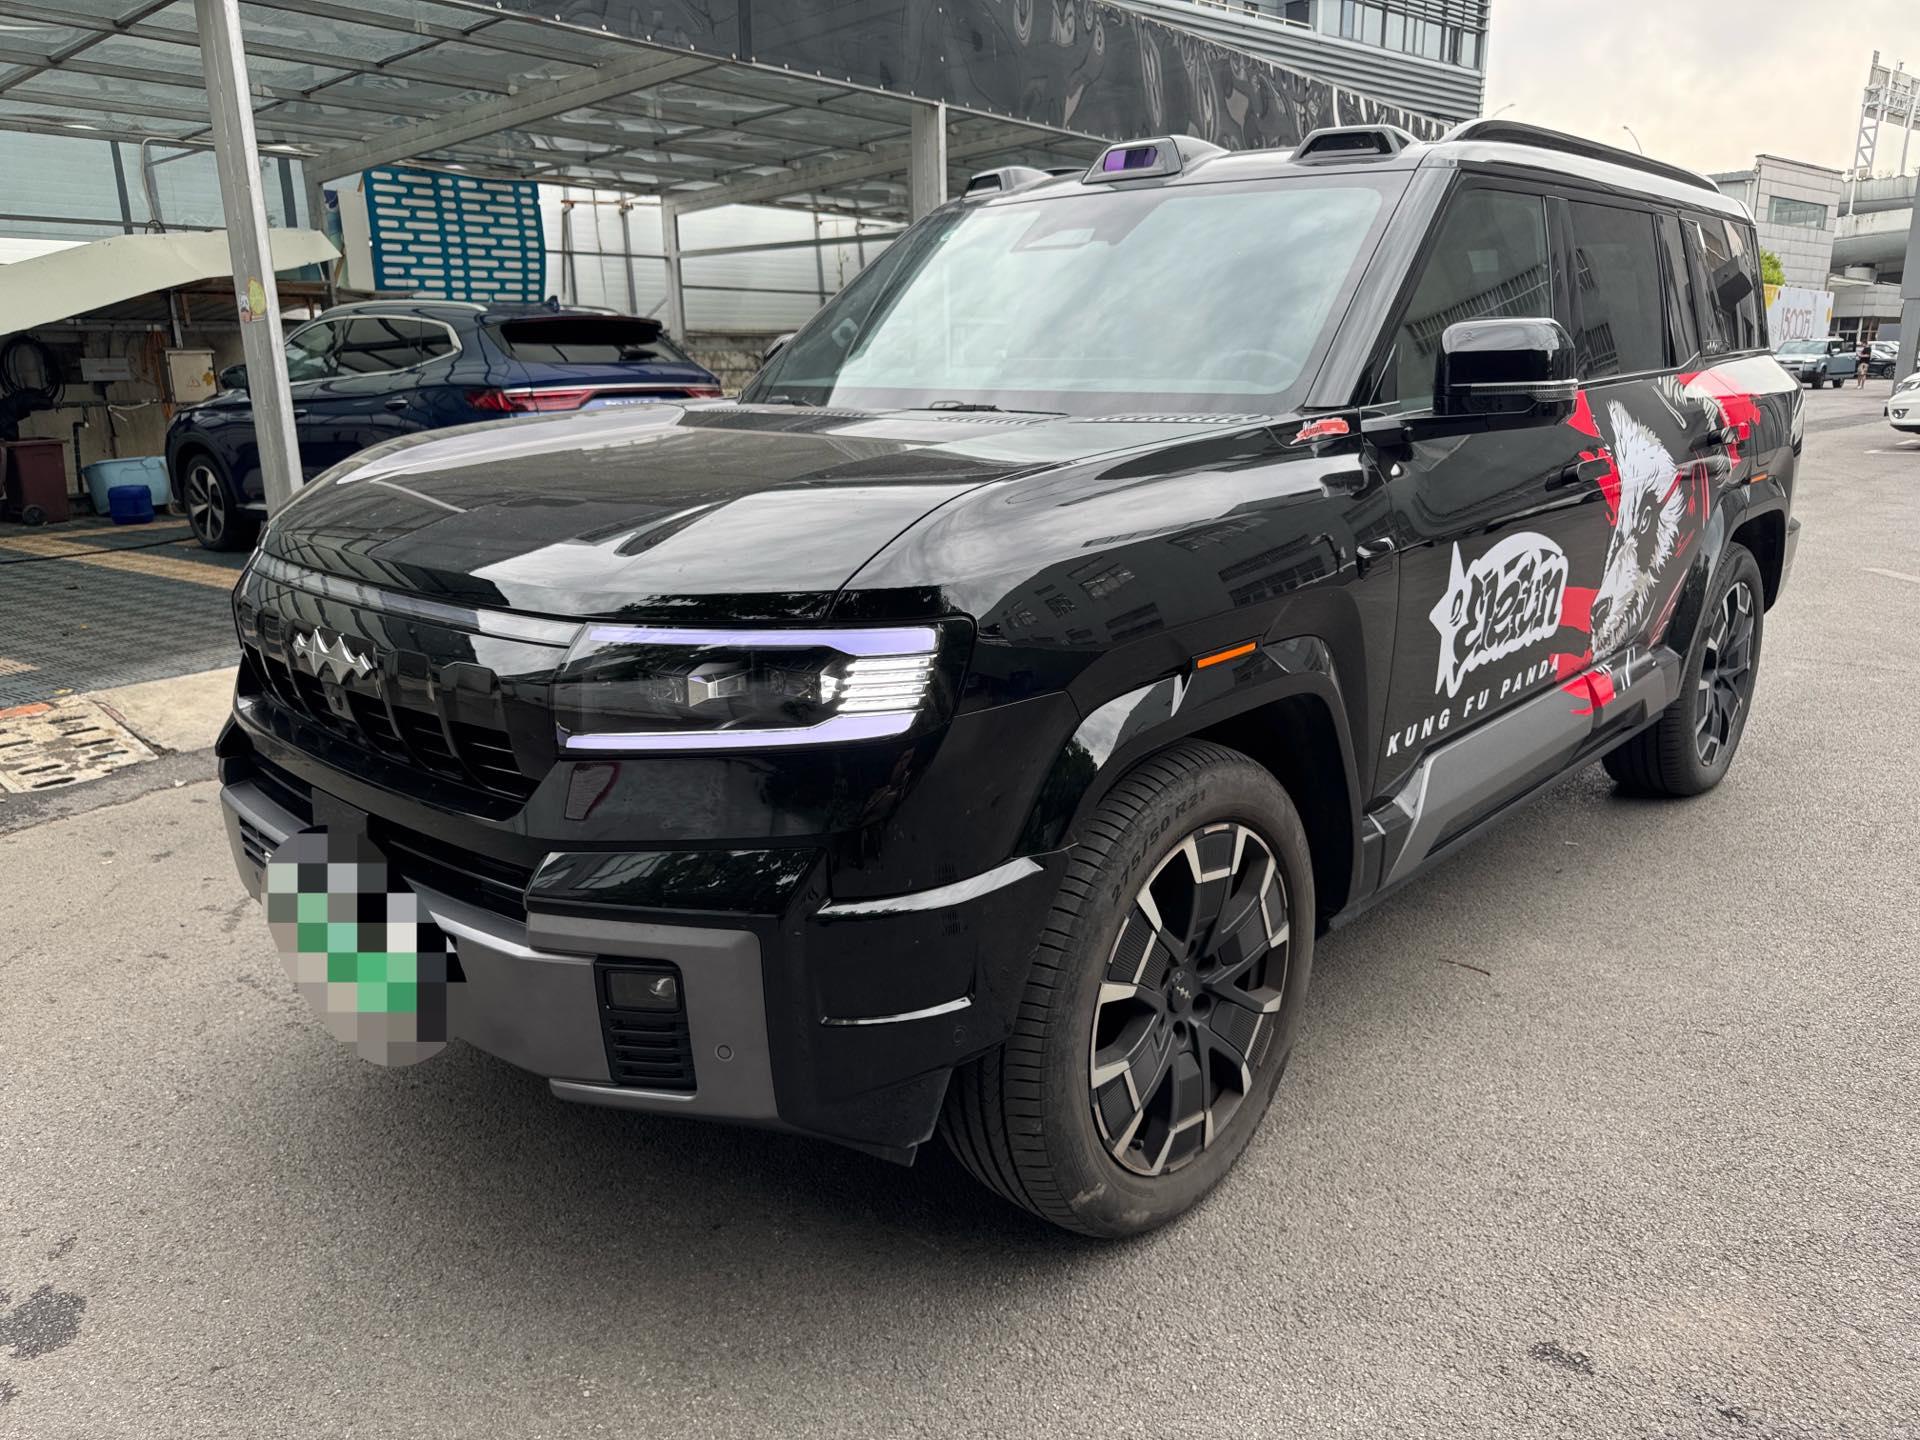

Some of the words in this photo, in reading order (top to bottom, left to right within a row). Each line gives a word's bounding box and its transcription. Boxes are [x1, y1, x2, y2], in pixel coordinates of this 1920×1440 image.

[1386, 708, 1451, 757] KUNG
[1463, 689, 1490, 718] FU
[1500, 654, 1560, 699] PANDA
[1112, 816, 1170, 906] 275/50
[1176, 790, 1206, 819] R21
